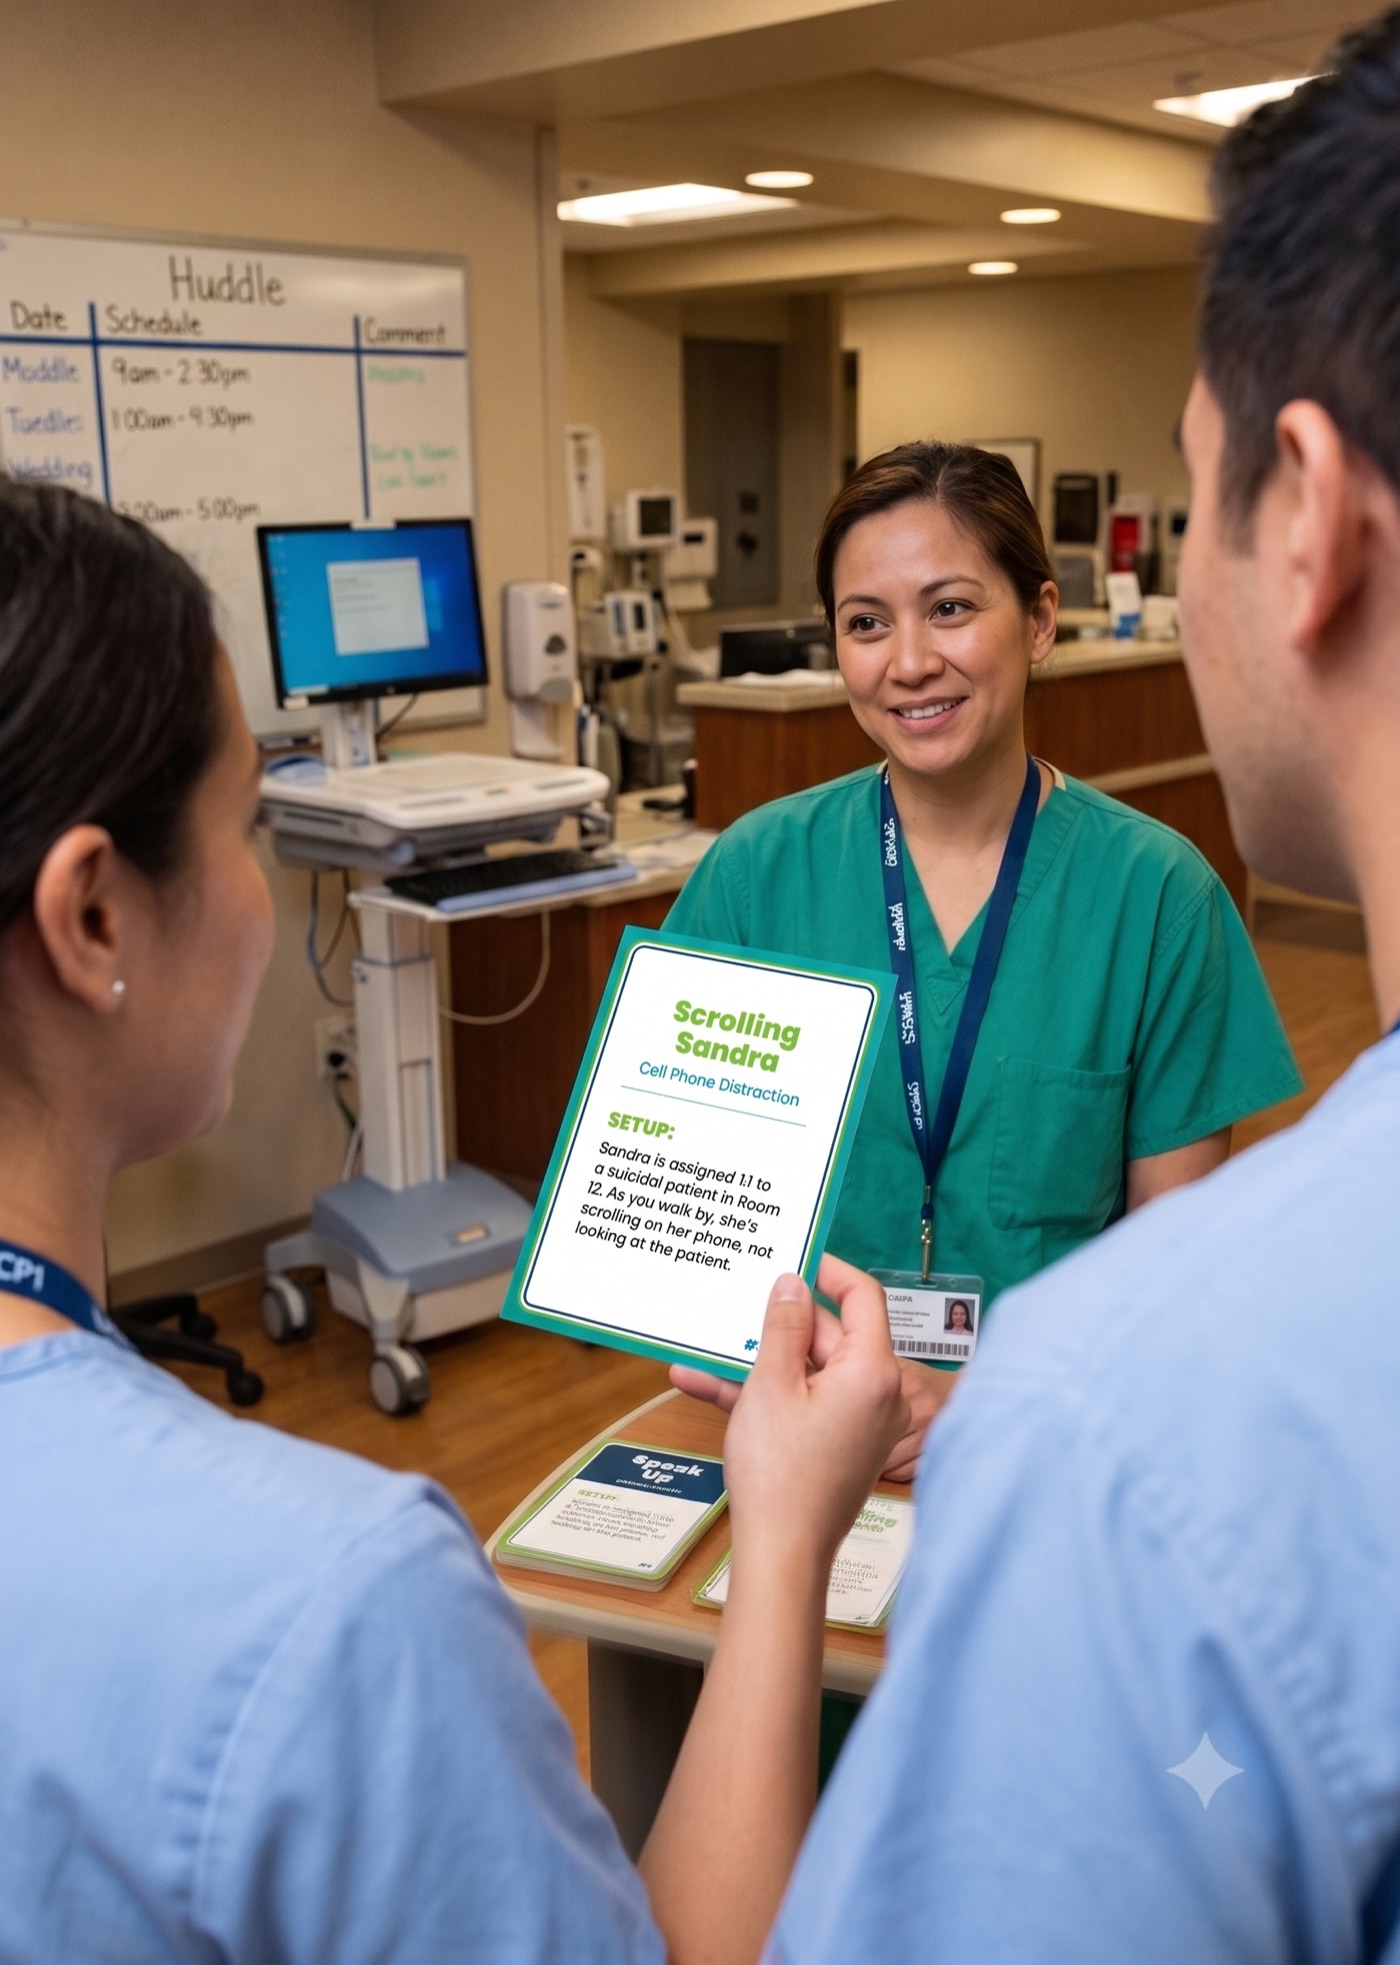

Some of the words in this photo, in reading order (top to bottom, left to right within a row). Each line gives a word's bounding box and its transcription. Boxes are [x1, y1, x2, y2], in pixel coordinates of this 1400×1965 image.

[168, 255, 287, 307] Huddle
[10, 300, 69, 332] Date
[105, 303, 203, 337] Schedule
[364, 316, 447, 345] Comment
[177, 357, 251, 391] 230pm
[674, 1000, 801, 1052] Scrolling
[675, 1031, 780, 1073] Sandra
[639, 1061, 668, 1079] Cell
[670, 1068, 716, 1089] Phone
[719, 1078, 800, 1107] Distraction
[607, 1111, 676, 1140] SETUP:
[599, 1141, 651, 1165] Sandra
[654, 1153, 666, 1168] is
[669, 1160, 737, 1185] assigned
[740, 1174, 754, 1188] 1:1
[757, 1178, 772, 1192] to
[587, 1181, 603, 1197] 12.
[606, 1187, 626, 1202] As
[627, 1193, 656, 1209] you
[659, 1201, 693, 1217] walk
[695, 1207, 715, 1227] by,
[719, 1214, 759, 1234] she's
[594, 1164, 605, 1175] a
[607, 1167, 664, 1189] suicidal
[664, 1180, 718, 1202] patient
[721, 1190, 734, 1206] in
[737, 1195, 781, 1217] Room
[574, 1220, 627, 1249] looking
[630, 1237, 647, 1250] at
[650, 1239, 674, 1257] the
[675, 1249, 731, 1272] patient.
[580, 1203, 642, 1231] scrolling
[645, 1219, 663, 1233] on
[666, 1222, 692, 1239] her
[693, 1230, 743, 1254] phone,
[748, 1243, 774, 1260] not
[641, 1469, 675, 1484] Up
